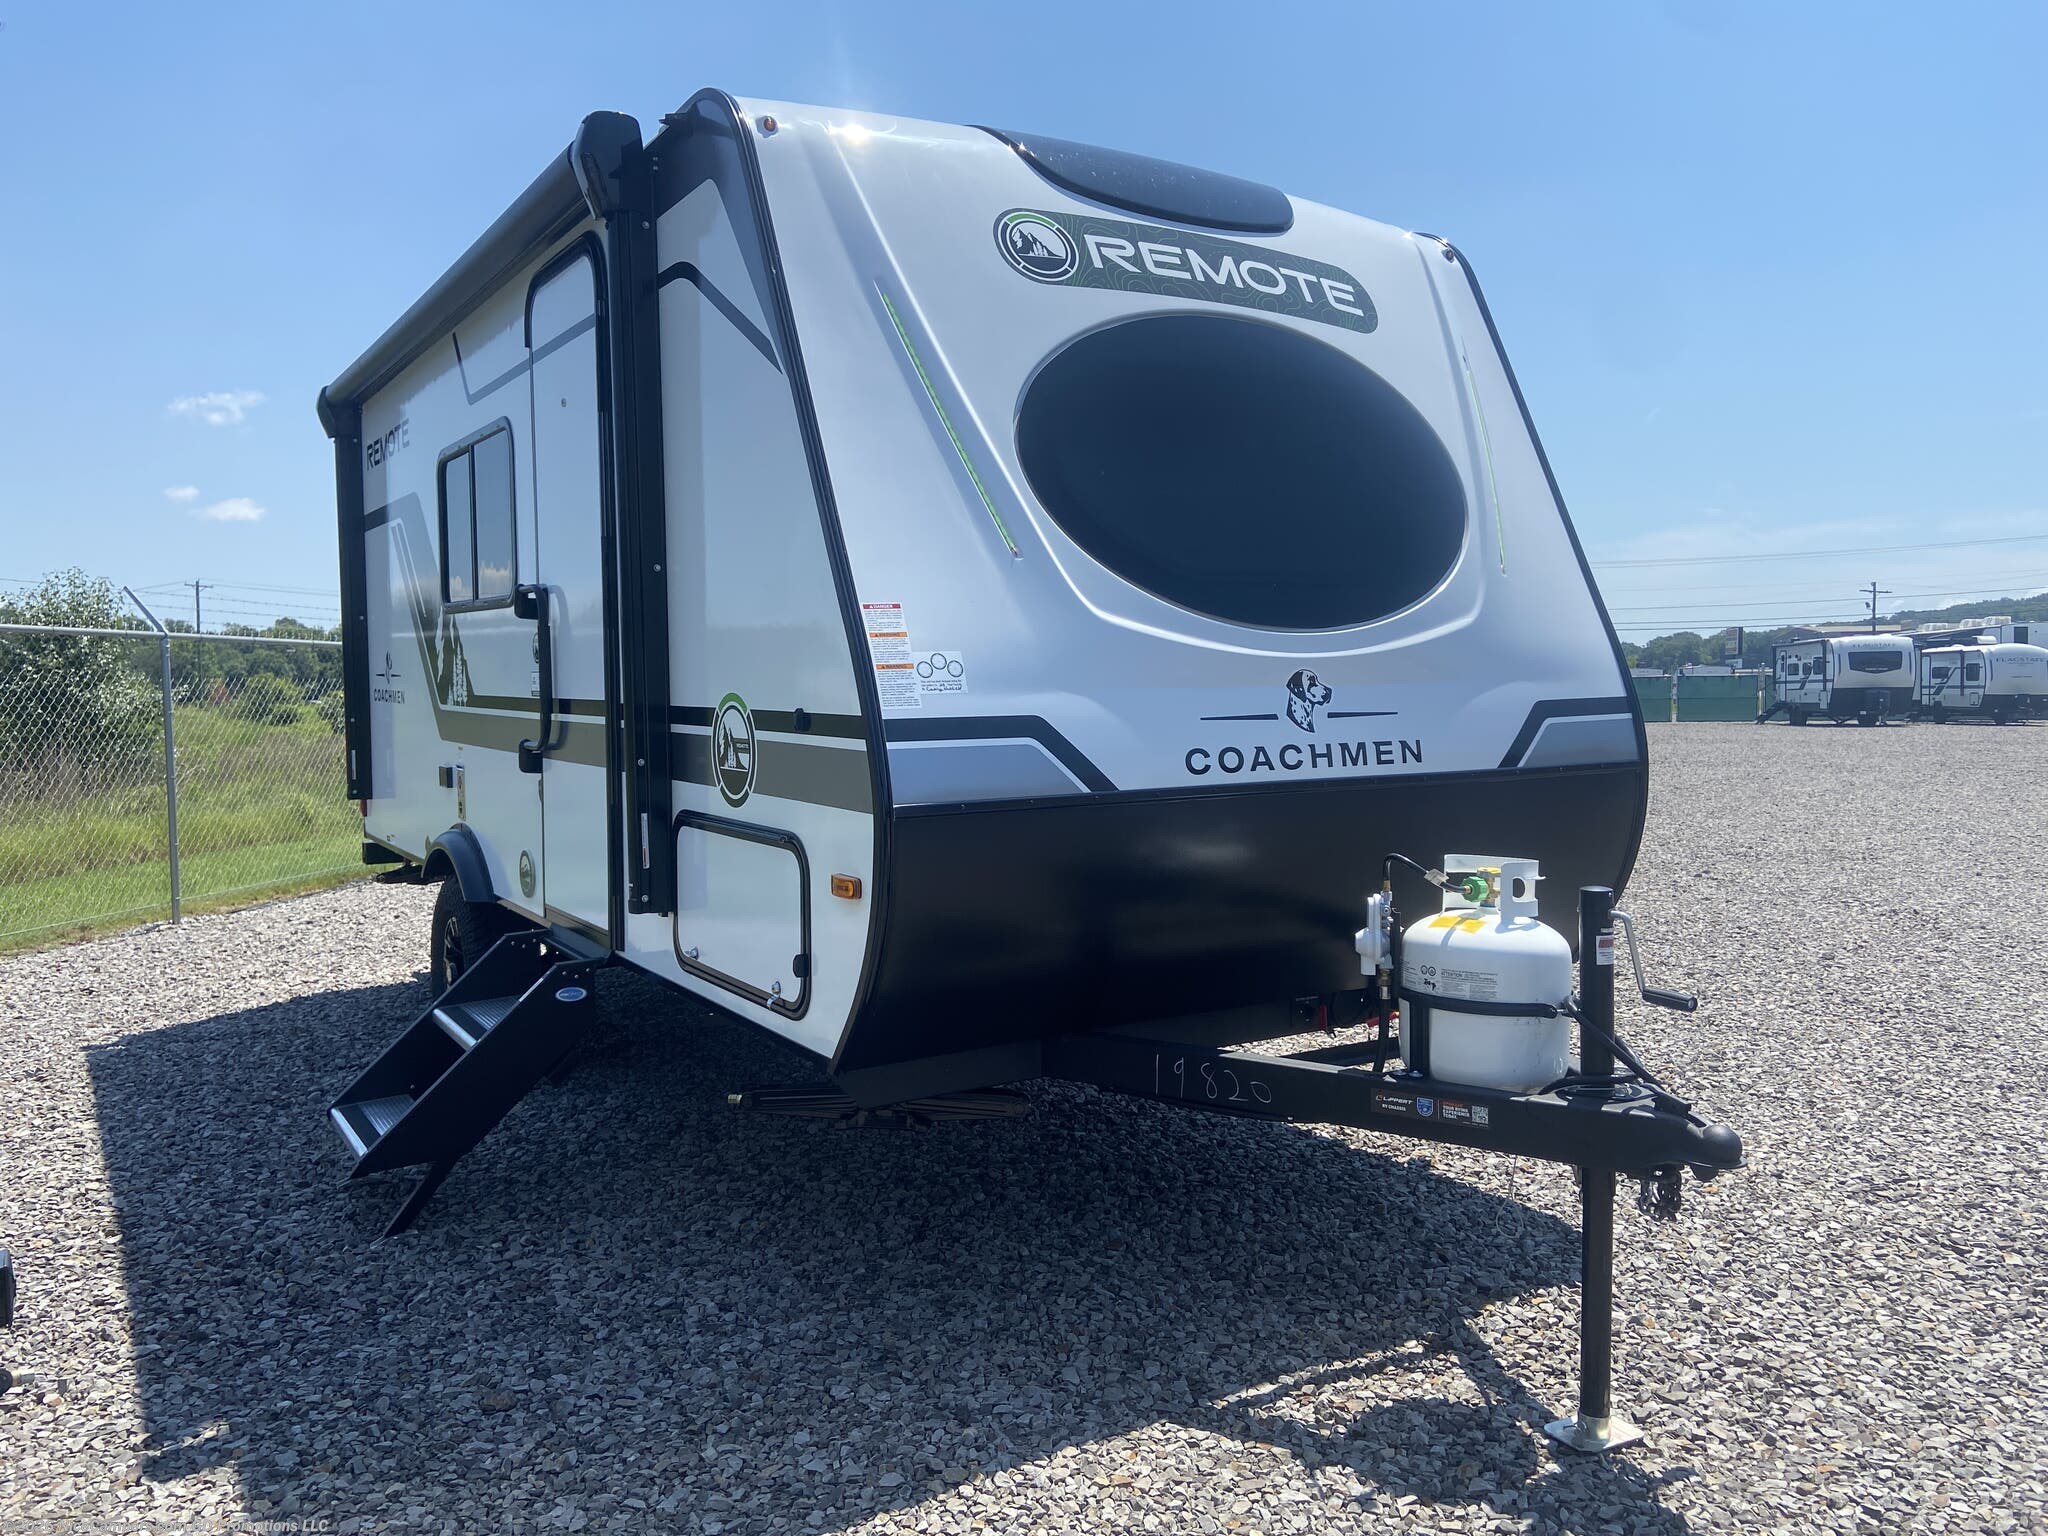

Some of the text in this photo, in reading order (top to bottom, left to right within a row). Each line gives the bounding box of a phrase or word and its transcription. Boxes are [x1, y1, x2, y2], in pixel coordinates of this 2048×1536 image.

[1083, 233, 1365, 317] REMOTE
[366, 418, 410, 471] REMOTE
[373, 688, 405, 704] COACHMEN
[1184, 739, 1423, 776] COACHMEN
[1154, 1053, 1272, 1104] 19820
